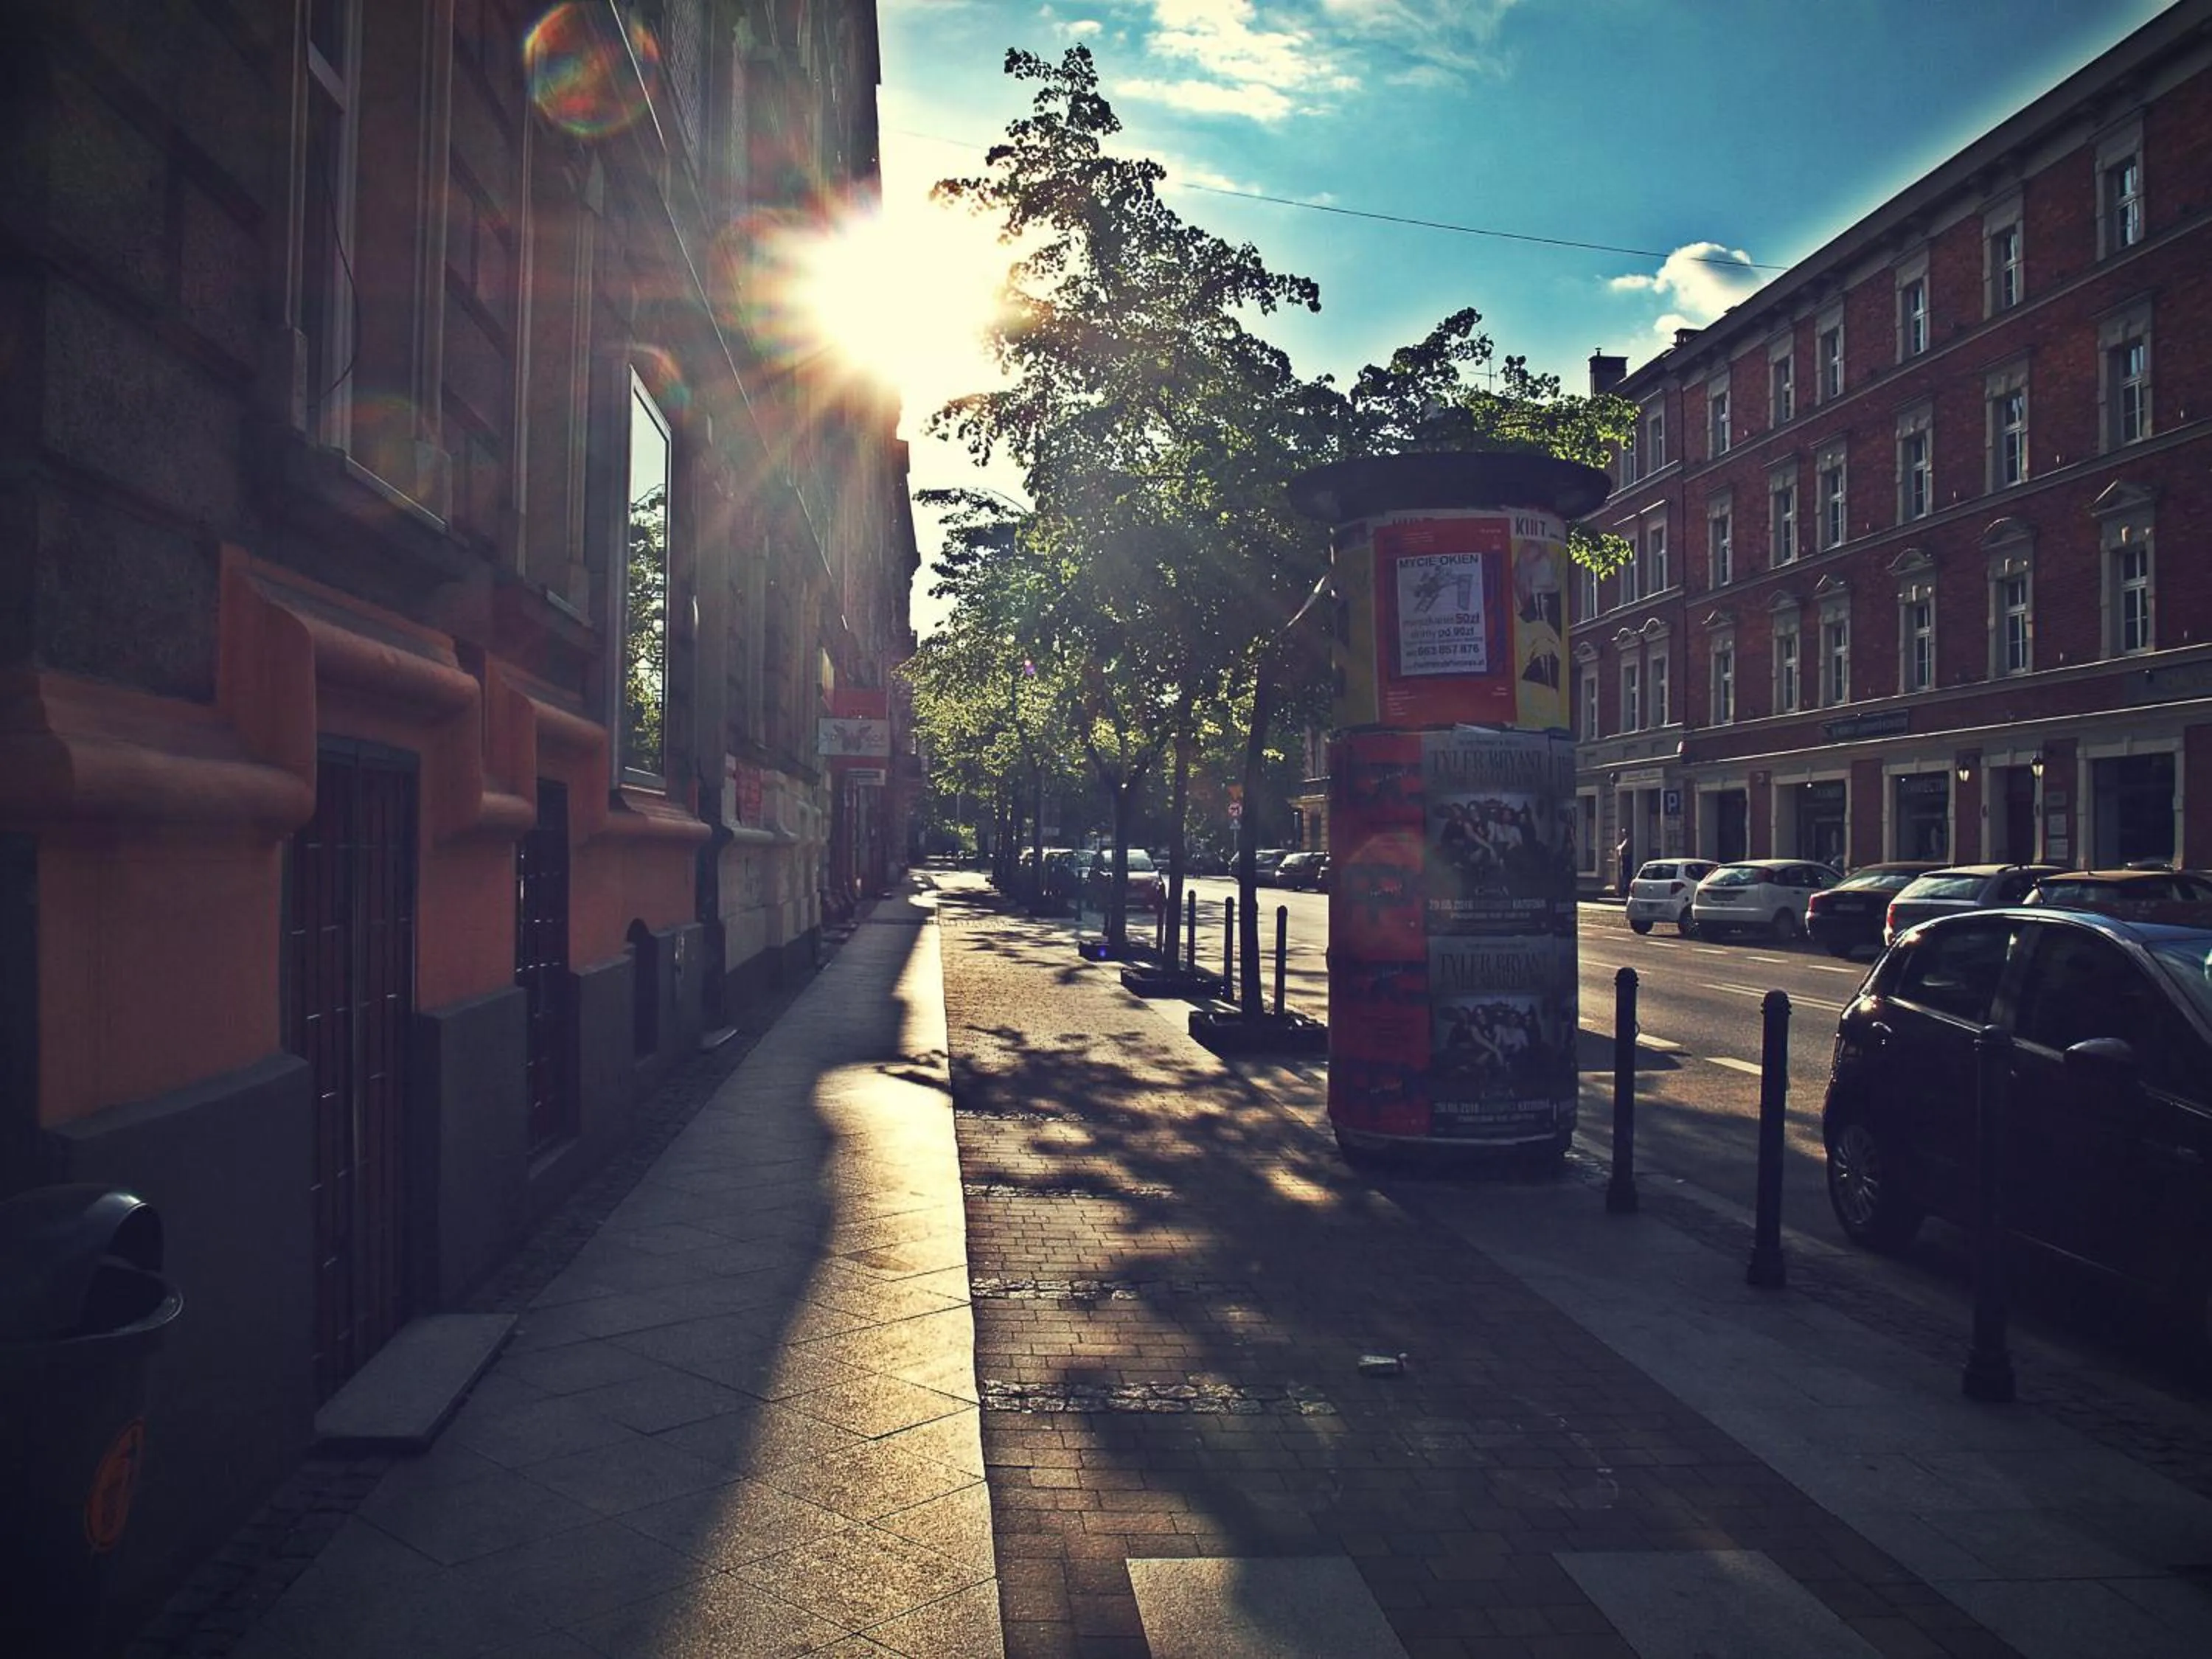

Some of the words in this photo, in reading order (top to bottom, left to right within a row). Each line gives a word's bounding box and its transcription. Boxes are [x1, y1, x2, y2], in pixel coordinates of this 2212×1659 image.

[1399, 557, 1436, 567] MYCIE
[1440, 554, 1478, 565] OKIEN
[1430, 749, 1484, 773] TYLER
[1667, 793, 1677, 813] P
